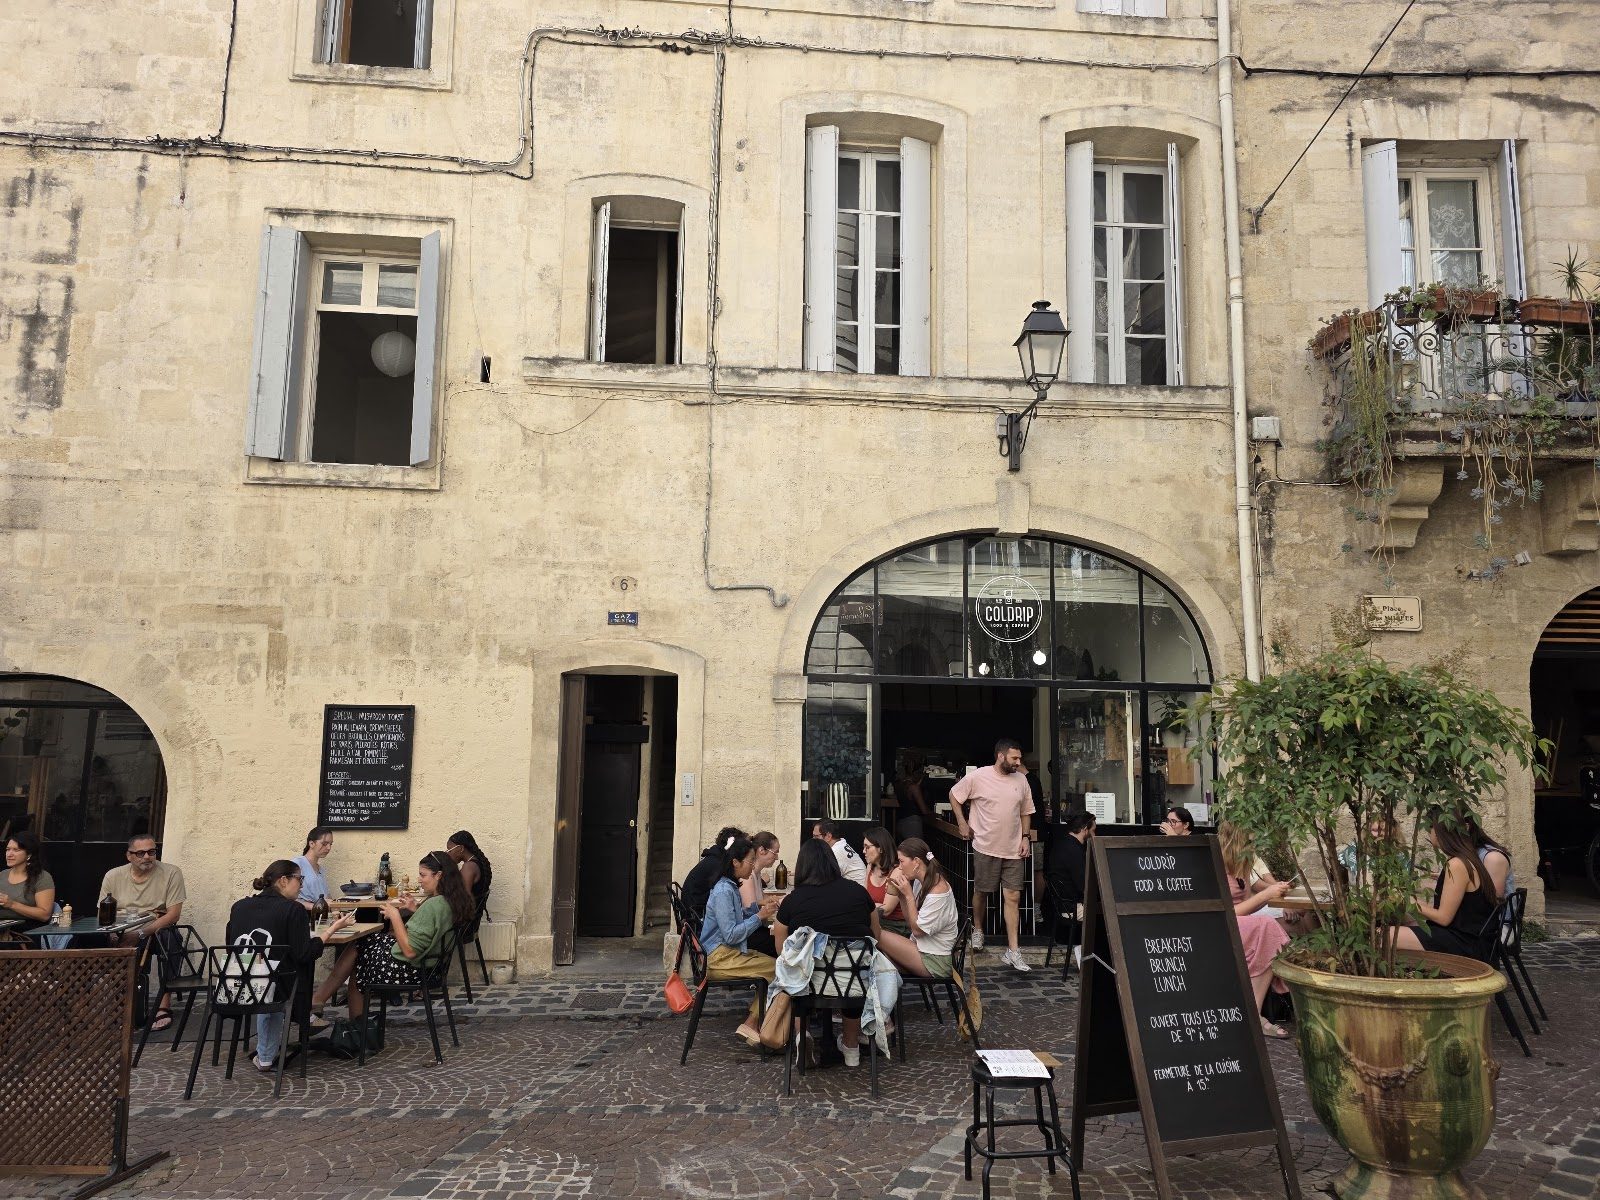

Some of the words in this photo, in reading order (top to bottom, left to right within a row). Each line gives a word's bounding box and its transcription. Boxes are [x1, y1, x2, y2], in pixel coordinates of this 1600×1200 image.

[620, 578, 628, 590] 6
[985, 606, 1034, 622] COLDRIP
[1134, 879, 1154, 892] FOOD
[1157, 879, 1164, 891] &
[1166, 878, 1193, 891] COFFEE
[1144, 936, 1193, 953] BREAKFAST
[1150, 956, 1187, 973] BRUNCH
[1154, 975, 1187, 992] LUNCH
[1150, 1014, 1179, 1028] OUVERT
[1181, 1011, 1201, 1026] TOUS
[1202, 1010, 1217, 1024] LES
[1218, 1007, 1242, 1023] JOURS
[1171, 1030, 1183, 1042] DE
[1154, 1064, 1191, 1080] FERMETURE
[1194, 1064, 1204, 1076] DE
[1205, 1064, 1214, 1075] LA
